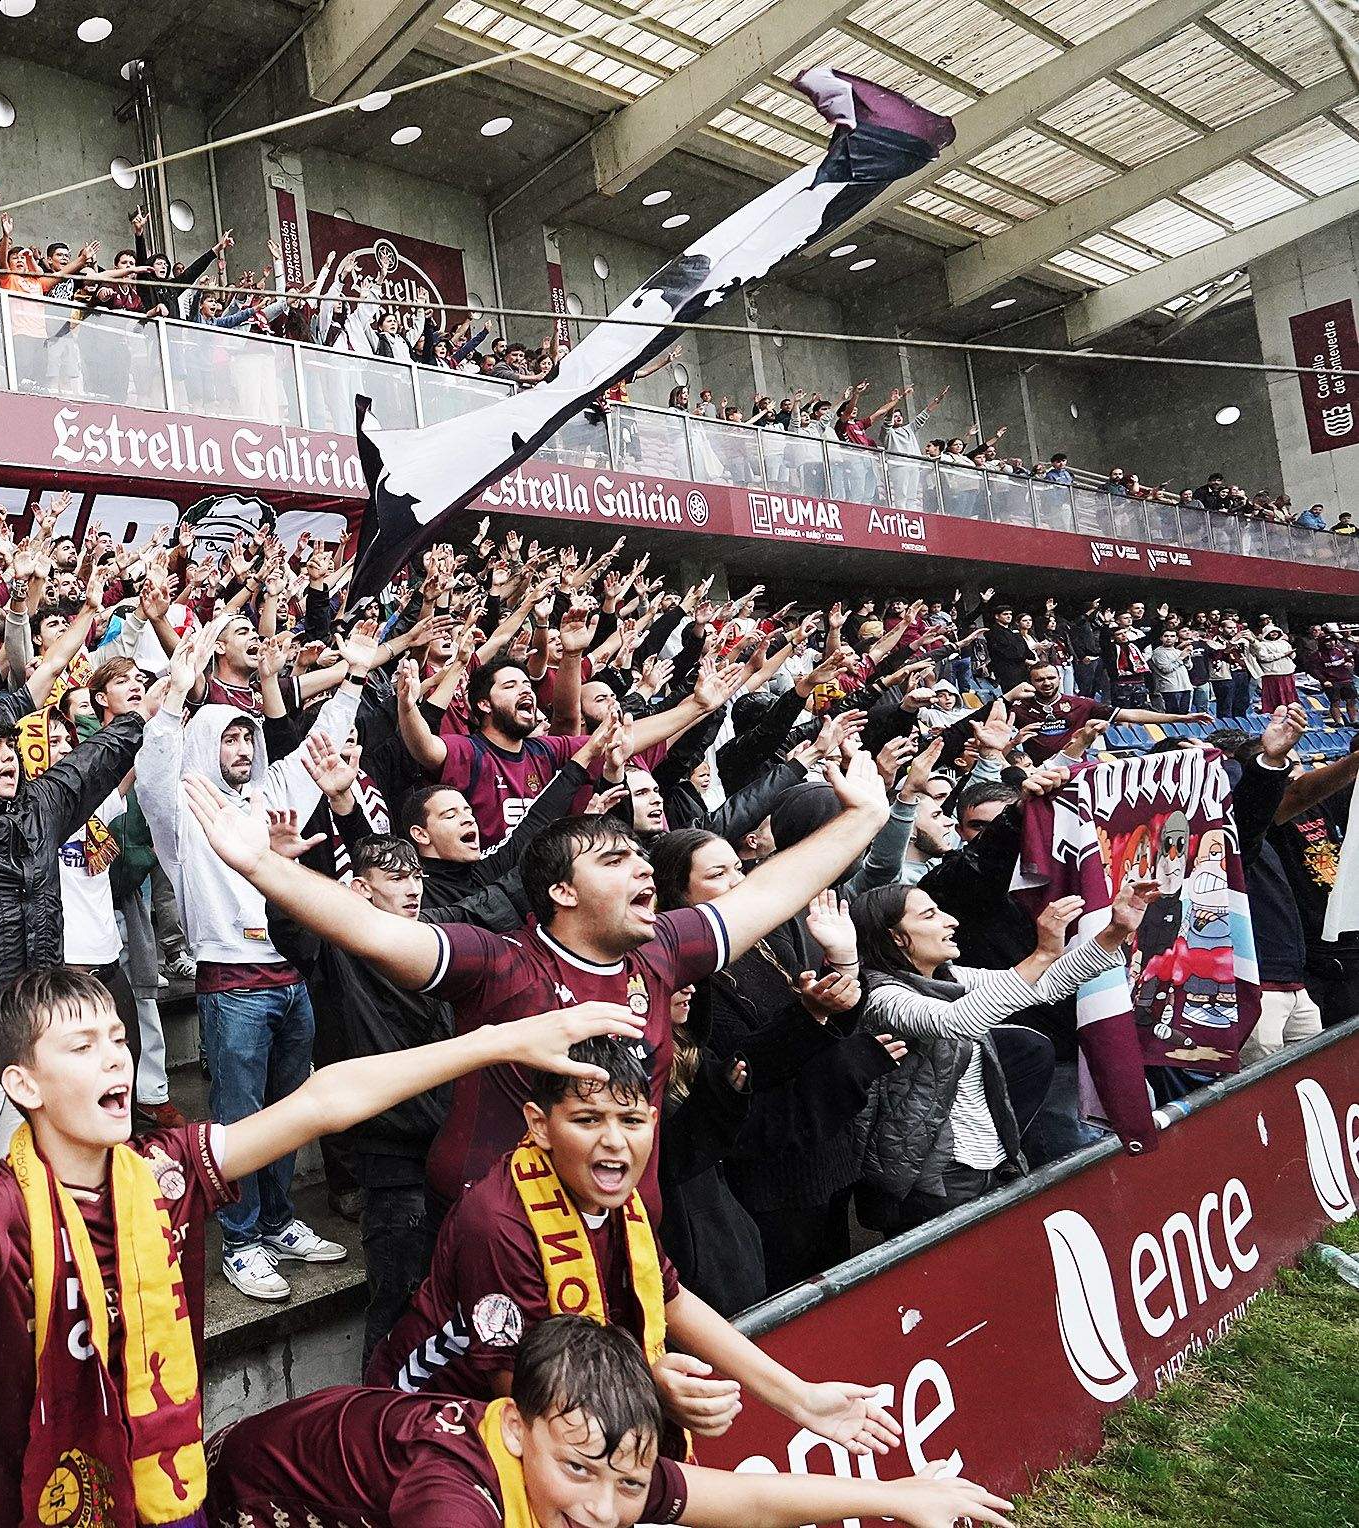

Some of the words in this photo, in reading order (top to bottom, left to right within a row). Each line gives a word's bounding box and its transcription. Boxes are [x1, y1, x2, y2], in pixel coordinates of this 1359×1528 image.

[281, 220, 294, 283] Deputación
[289, 222, 303, 285] Pontevedra
[552, 287, 563, 341] Depación
[1333, 379, 1346, 394] de
[52, 407, 226, 477] Estrella
[232, 428, 367, 490] Galicia
[593, 475, 683, 524] Galicia
[770, 496, 843, 530] PUMAR
[867, 507, 926, 540] Arrital
[1131, 1177, 1260, 1338] ence
